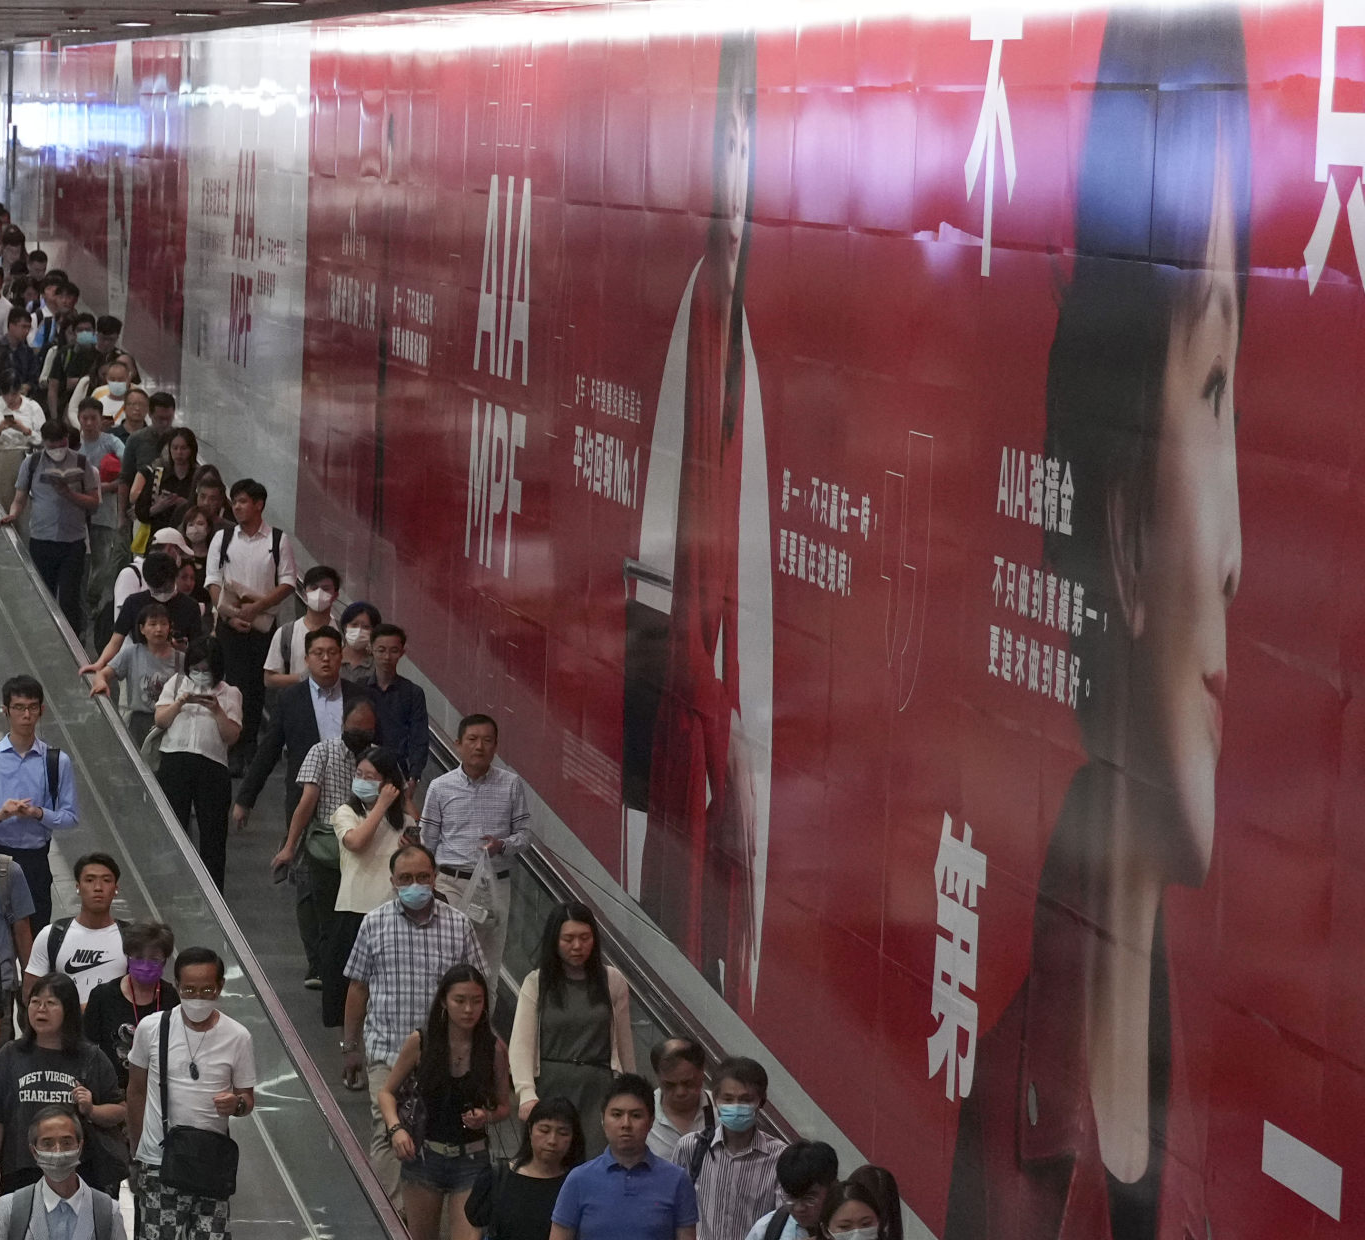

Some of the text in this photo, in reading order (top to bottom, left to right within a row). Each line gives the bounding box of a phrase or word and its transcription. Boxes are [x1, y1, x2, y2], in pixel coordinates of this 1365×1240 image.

[232, 148, 257, 262] AIA
[228, 271, 254, 369] MPF
[473, 174, 532, 386] AIA
[464, 398, 527, 579] MPF
[72, 949, 105, 964] NIKE
[927, 811, 988, 1103] 第
[18, 1071, 43, 1089] WEST
